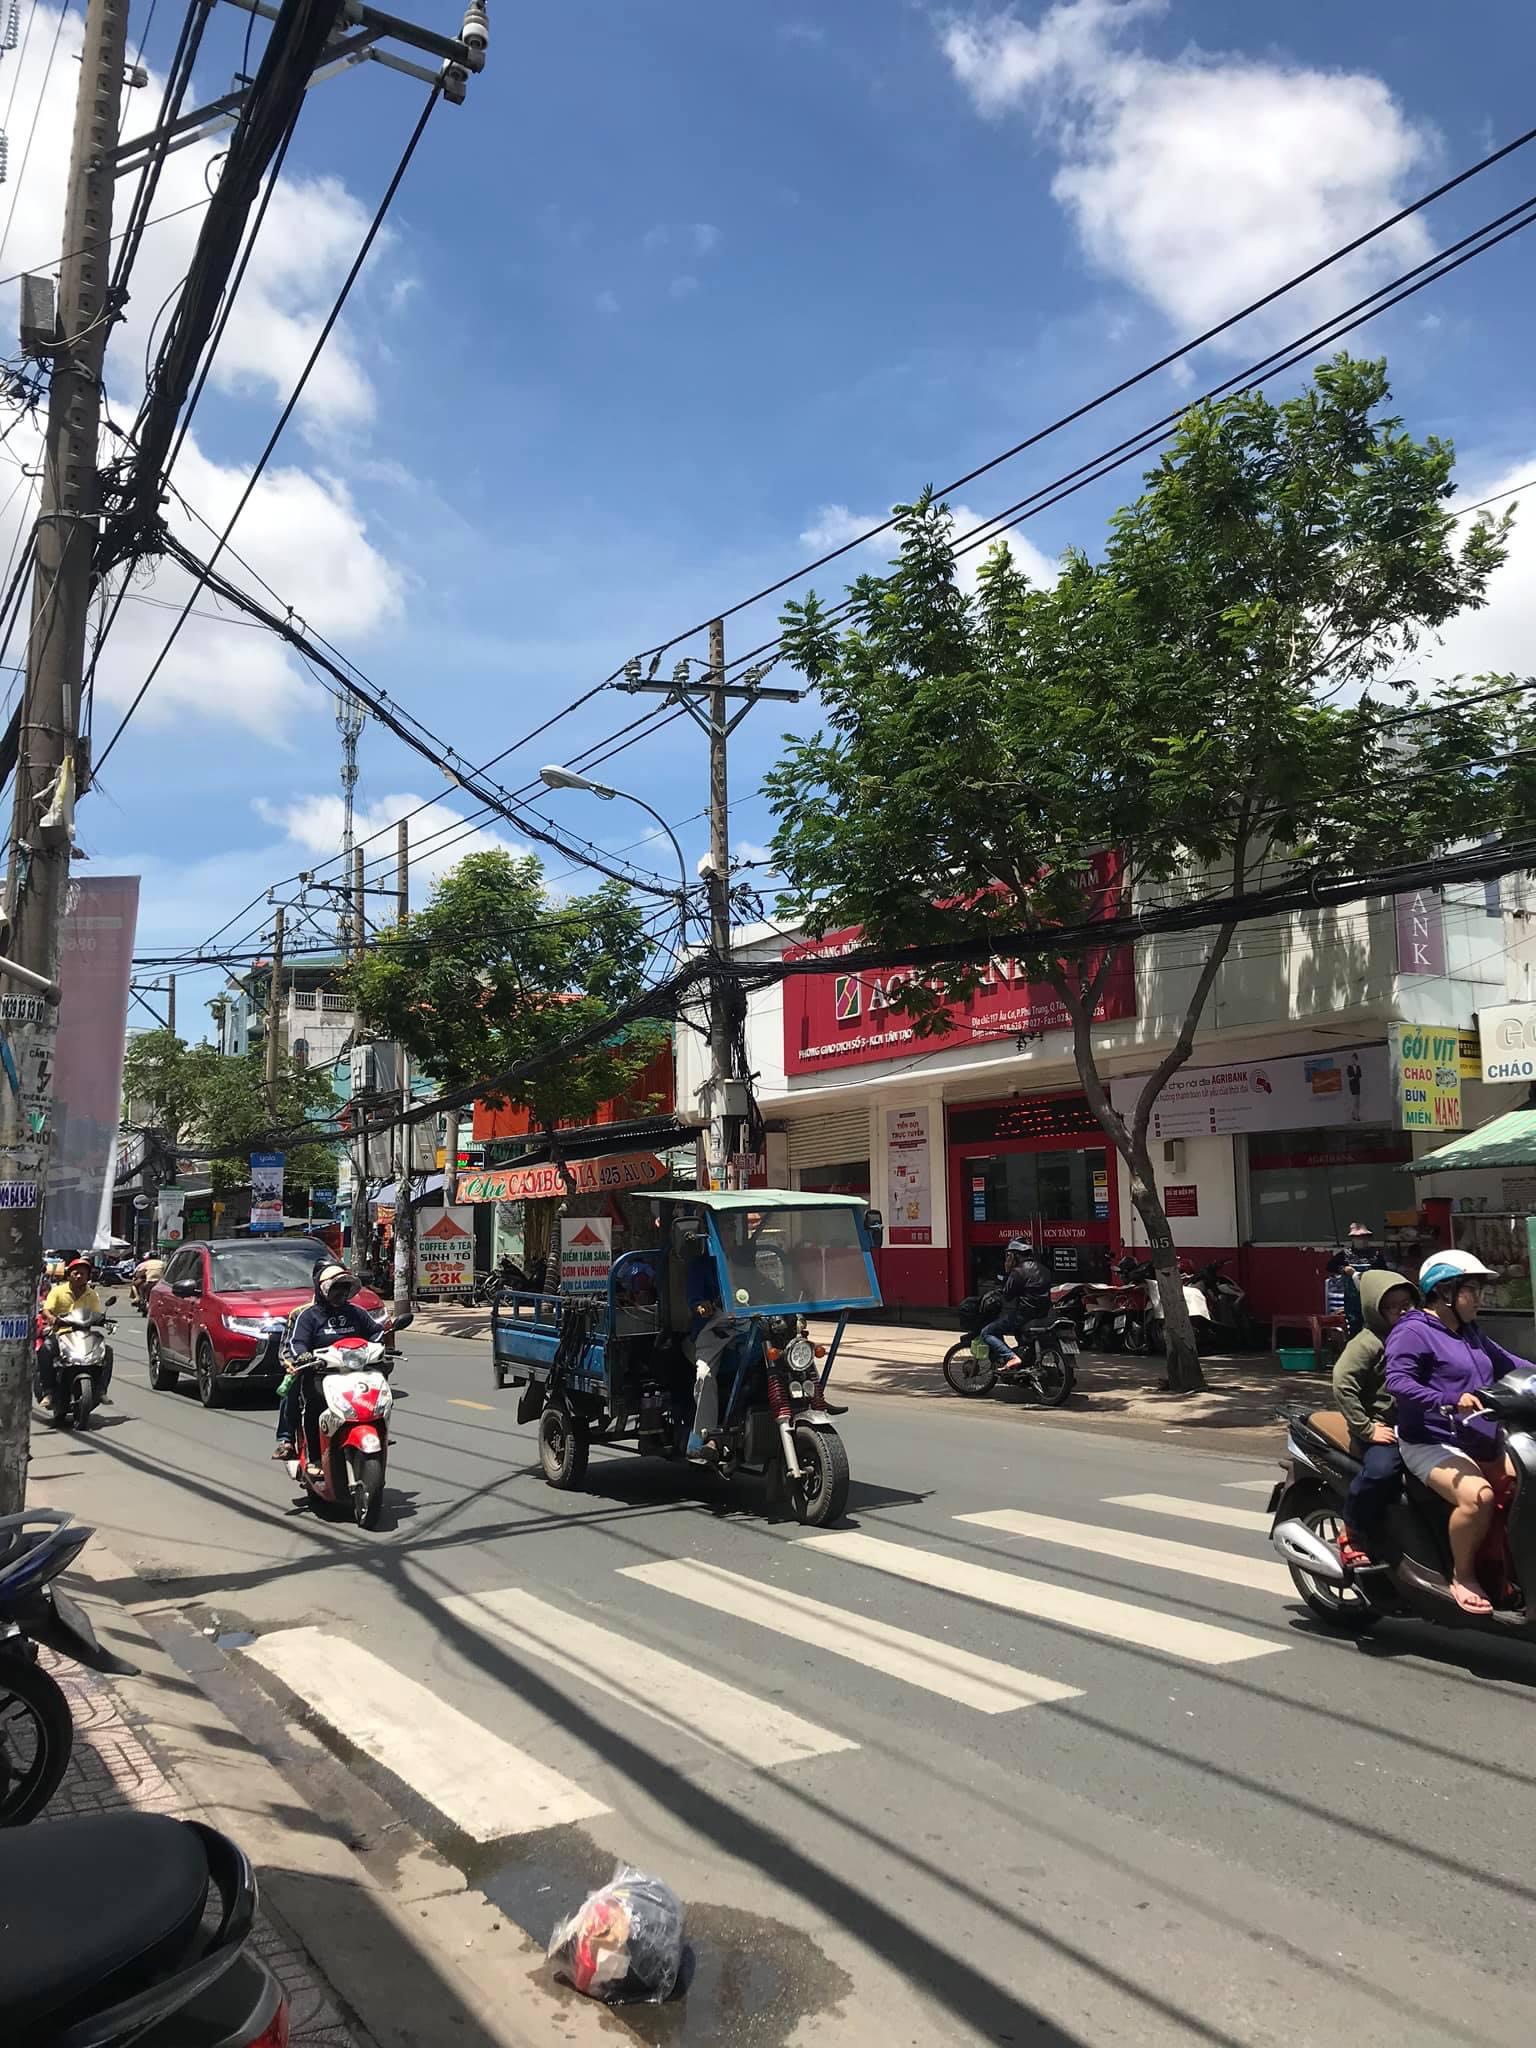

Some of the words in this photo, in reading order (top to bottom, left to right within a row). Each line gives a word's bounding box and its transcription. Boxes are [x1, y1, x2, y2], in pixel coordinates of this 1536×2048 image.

[1404, 1065, 1432, 1081] CHÁO
[1487, 1059, 1534, 1079] CHÁO
[1211, 1071, 1248, 1085] AGRIBANK
[1405, 1086, 1426, 1102] BÚN
[466, 1176, 506, 1199] Chè
[600, 1167, 620, 1186] 425
[623, 1159, 640, 1182] ÂU
[1058, 1227, 1071, 1238] TÂN
[419, 1242, 447, 1251] COFFEE
[450, 1242, 455, 1250] &
[458, 1241, 472, 1250] TEA
[420, 1253, 449, 1261] SINH
[425, 1261, 465, 1272] Chè
[429, 1272, 461, 1284] 23K
